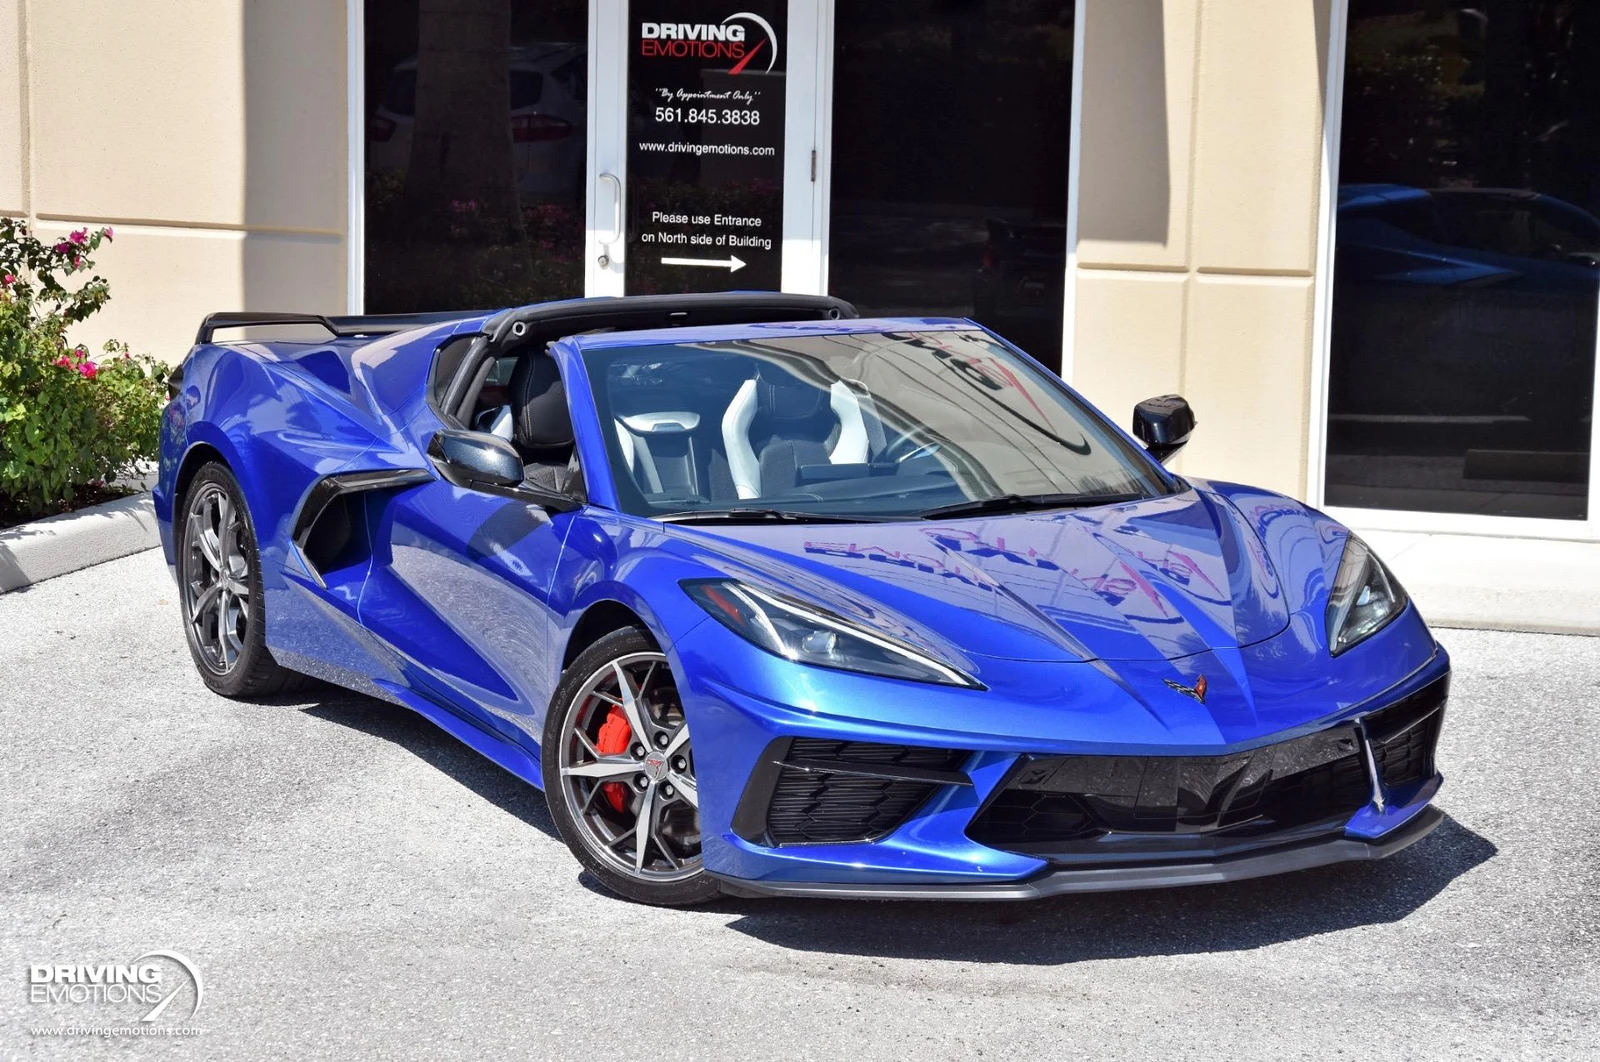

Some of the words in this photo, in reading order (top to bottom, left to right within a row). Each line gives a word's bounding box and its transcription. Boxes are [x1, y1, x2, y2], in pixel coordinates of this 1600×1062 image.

[641, 22, 745, 41] DRIVING
[642, 40, 745, 59] EMOTIONS
[677, 88, 731, 102] Appointment
[655, 107, 760, 125] 561.845.3838
[639, 142, 775, 156] www.drivingemotions.com
[652, 211, 689, 224] Please
[691, 216, 711, 225] use
[714, 214, 762, 227] Entrance
[641, 233, 655, 243] on
[658, 232, 687, 244] North
[690, 234, 713, 245] side
[715, 235, 726, 246] of
[729, 235, 772, 250] Building
